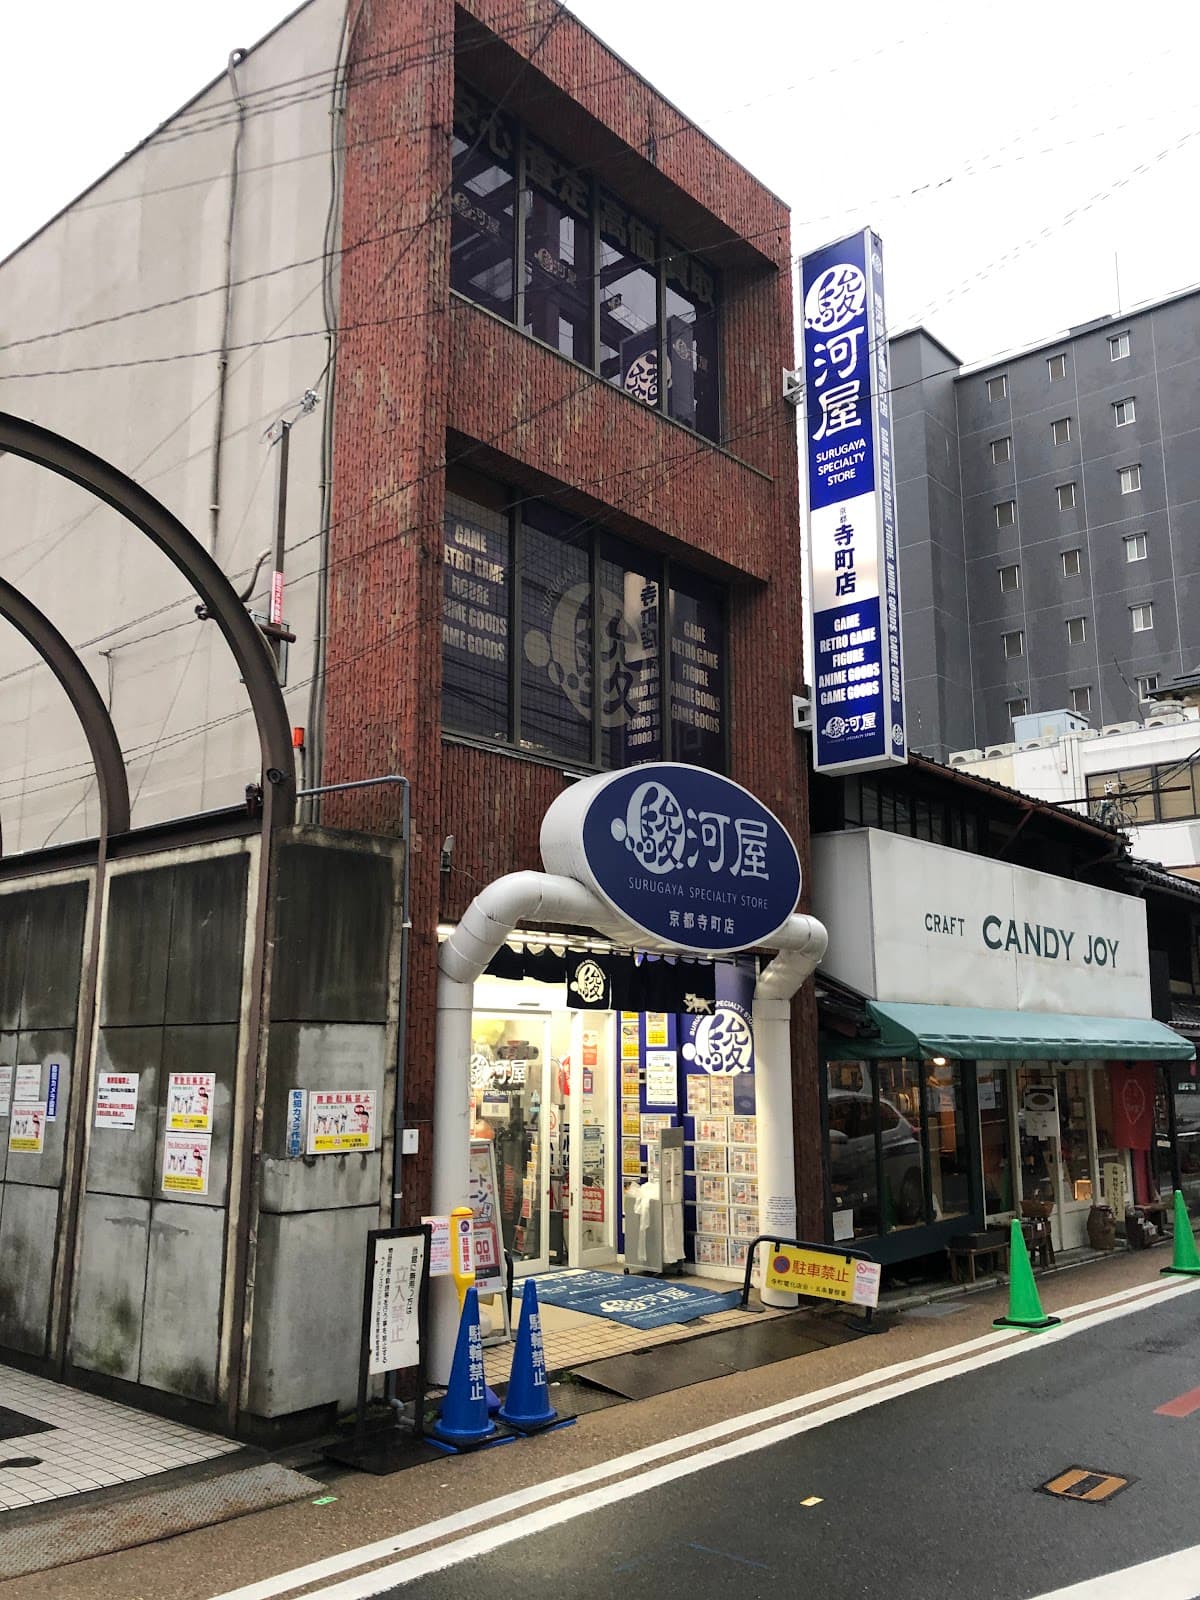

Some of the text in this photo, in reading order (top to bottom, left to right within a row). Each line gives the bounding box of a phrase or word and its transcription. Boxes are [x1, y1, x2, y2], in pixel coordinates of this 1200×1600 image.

[804, 263, 866, 441] 駿河屋
[816, 438, 867, 463] SURUGAYA
[817, 452, 865, 476] SPECIALTY
[827, 469, 856, 486] STORE
[454, 524, 487, 553] GAME
[444, 544, 505, 585] ETRO GAME
[451, 573, 490, 606] FIGURE
[468, 607, 507, 636] GOODS
[683, 620, 706, 644] GAME
[834, 613, 860, 633] GAME
[442, 623, 505, 662] AME GOODS
[671, 637, 719, 670] RETRO GAME
[820, 626, 876, 654] RETRO GAME
[889, 634, 900, 666] GAME
[832, 647, 865, 668] FIGURE
[682, 663, 709, 687] FIGURE
[818, 662, 880, 689] ANIME GOODS
[890, 664, 901, 702] GOODS
[671, 681, 721, 713] ANIME GOODS
[820, 680, 880, 706] GAME GOODS
[671, 703, 695, 725] GAME
[694, 710, 720, 734] GOODS
[821, 711, 877, 739] 駿河屋
[611, 781, 770, 881] 駿河屋
[628, 877, 769, 910] SURUGAYA SPECIALTY STORE
[668, 910, 735, 935] 京都寺町店
[925, 913, 1120, 969] CRAFT CANDY JOY
[792, 1260, 849, 1283] 駐車禁止
